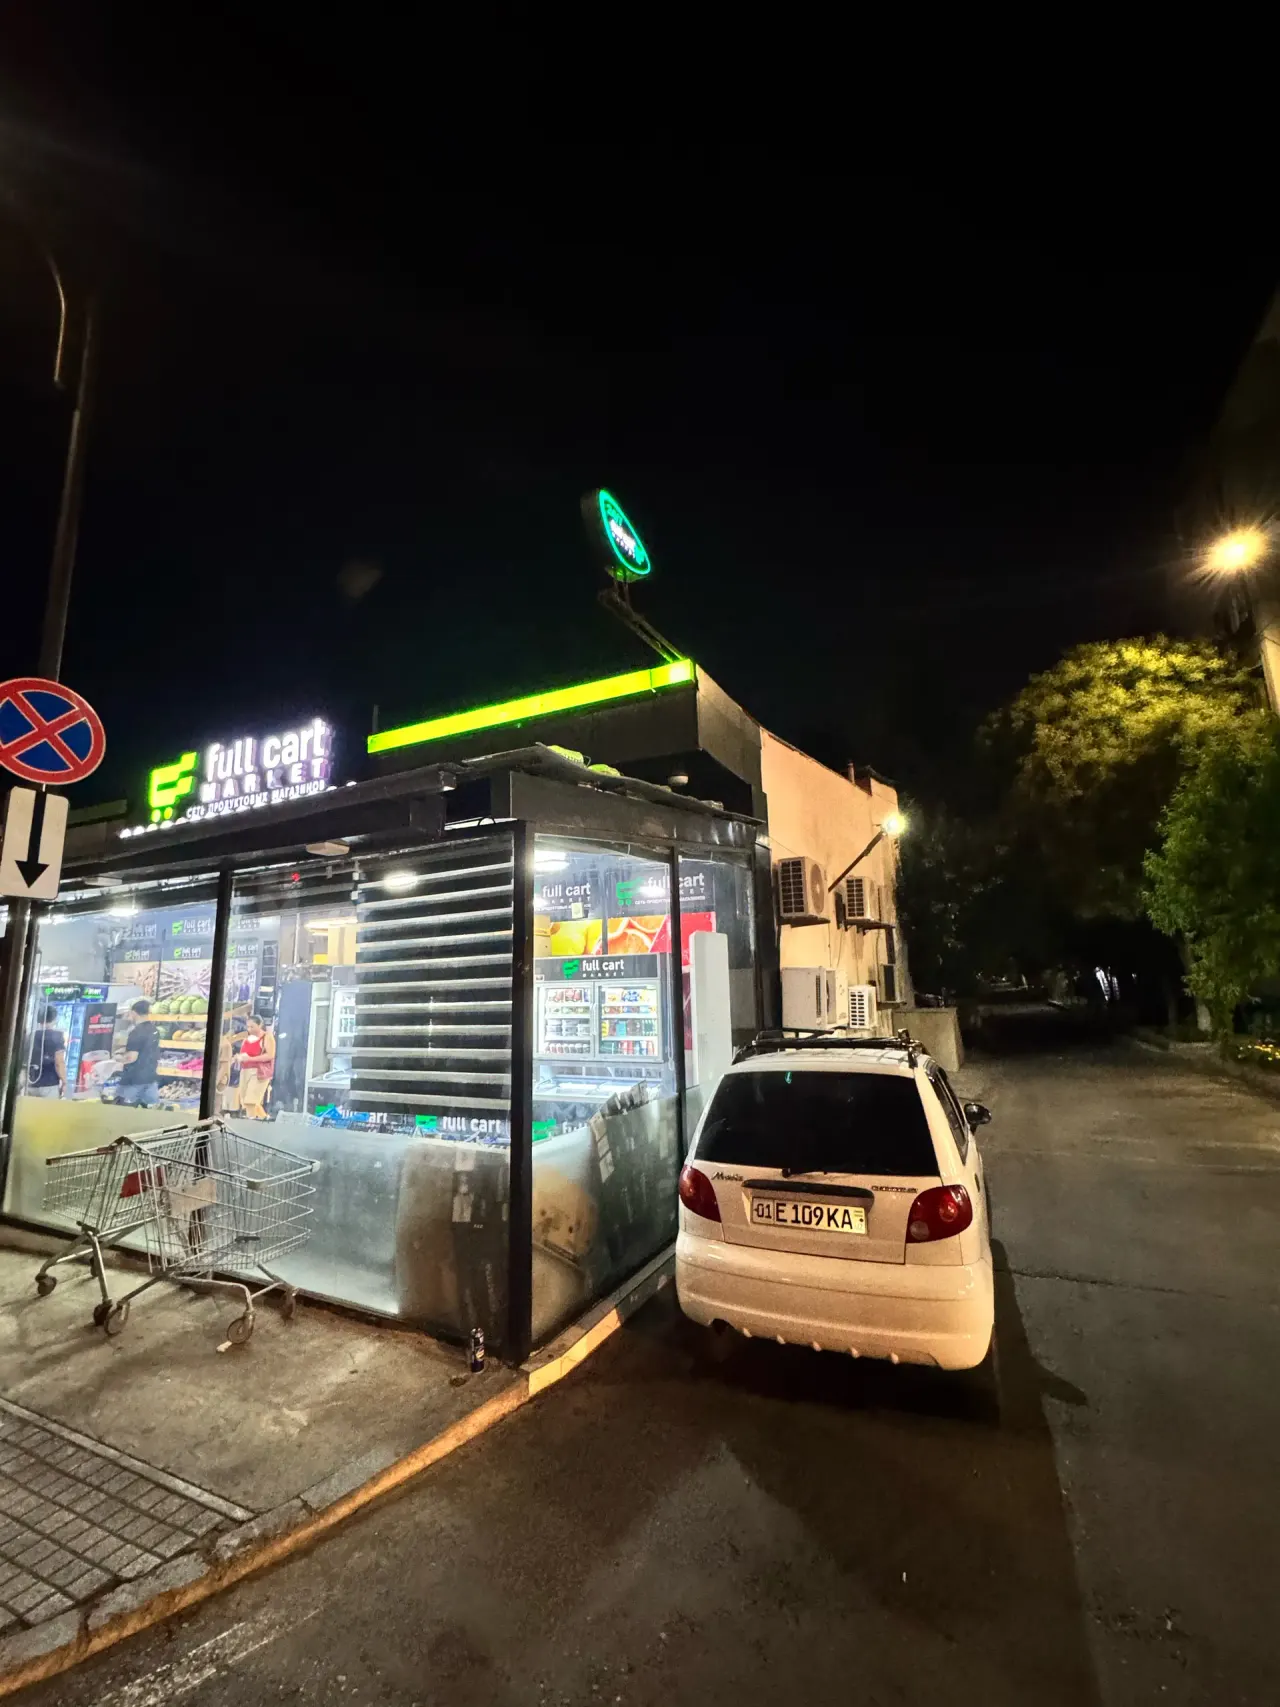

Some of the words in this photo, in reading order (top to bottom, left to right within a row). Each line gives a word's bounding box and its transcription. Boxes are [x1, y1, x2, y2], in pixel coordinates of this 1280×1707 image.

[206, 737, 255, 782] full
[263, 717, 327, 769] cart
[201, 757, 326, 803] MARKET
[186, 805, 205, 819] СЕТЬ
[208, 791, 268, 815] ПРОДУКТОВЫХ
[271, 779, 326, 803] МАГАЗИНОВ
[542, 884, 562, 898] full
[565, 882, 591, 896] cart
[582, 960, 600, 971] full
[602, 959, 624, 971] cart
[756, 1203, 772, 1219] 01
